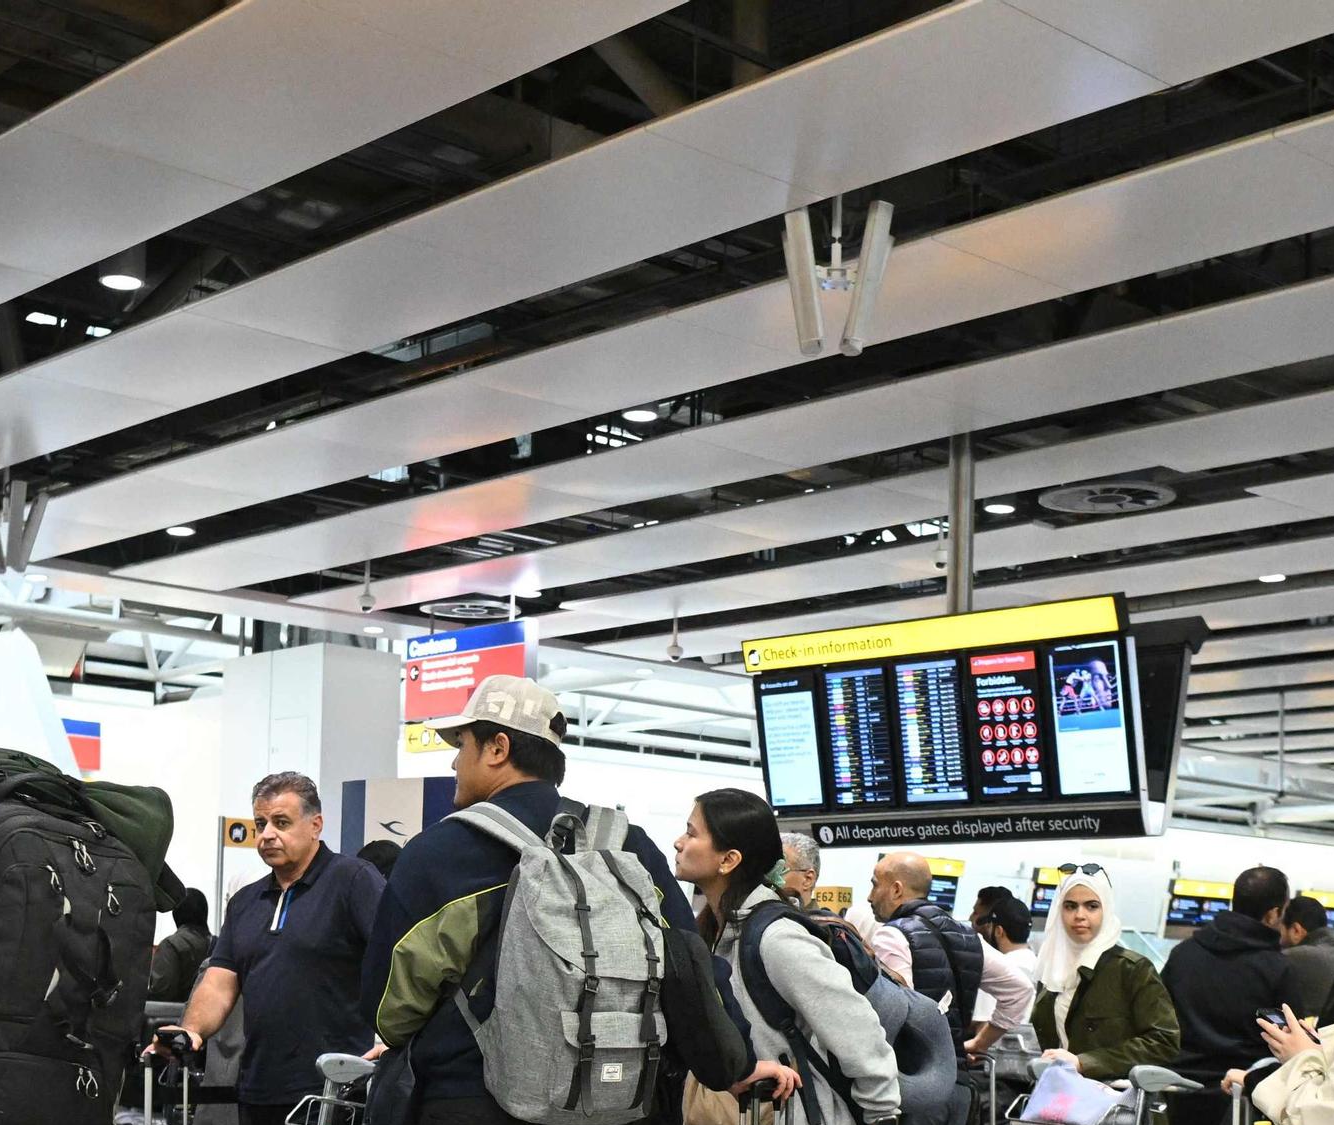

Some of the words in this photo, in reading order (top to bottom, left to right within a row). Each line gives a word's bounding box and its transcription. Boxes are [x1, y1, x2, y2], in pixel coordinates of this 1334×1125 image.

[763, 644, 815, 662] Check-in
[817, 636, 893, 655] information
[976, 675, 1016, 687] Forbidden
[835, 825, 850, 840] All
[852, 824, 915, 842] departures
[917, 824, 951, 840] gates
[952, 819, 1013, 838] displayed
[1015, 816, 1048, 832] after
[1048, 815, 1101, 834] security
[816, 891, 834, 902] E62
[838, 892, 852, 902] E62
